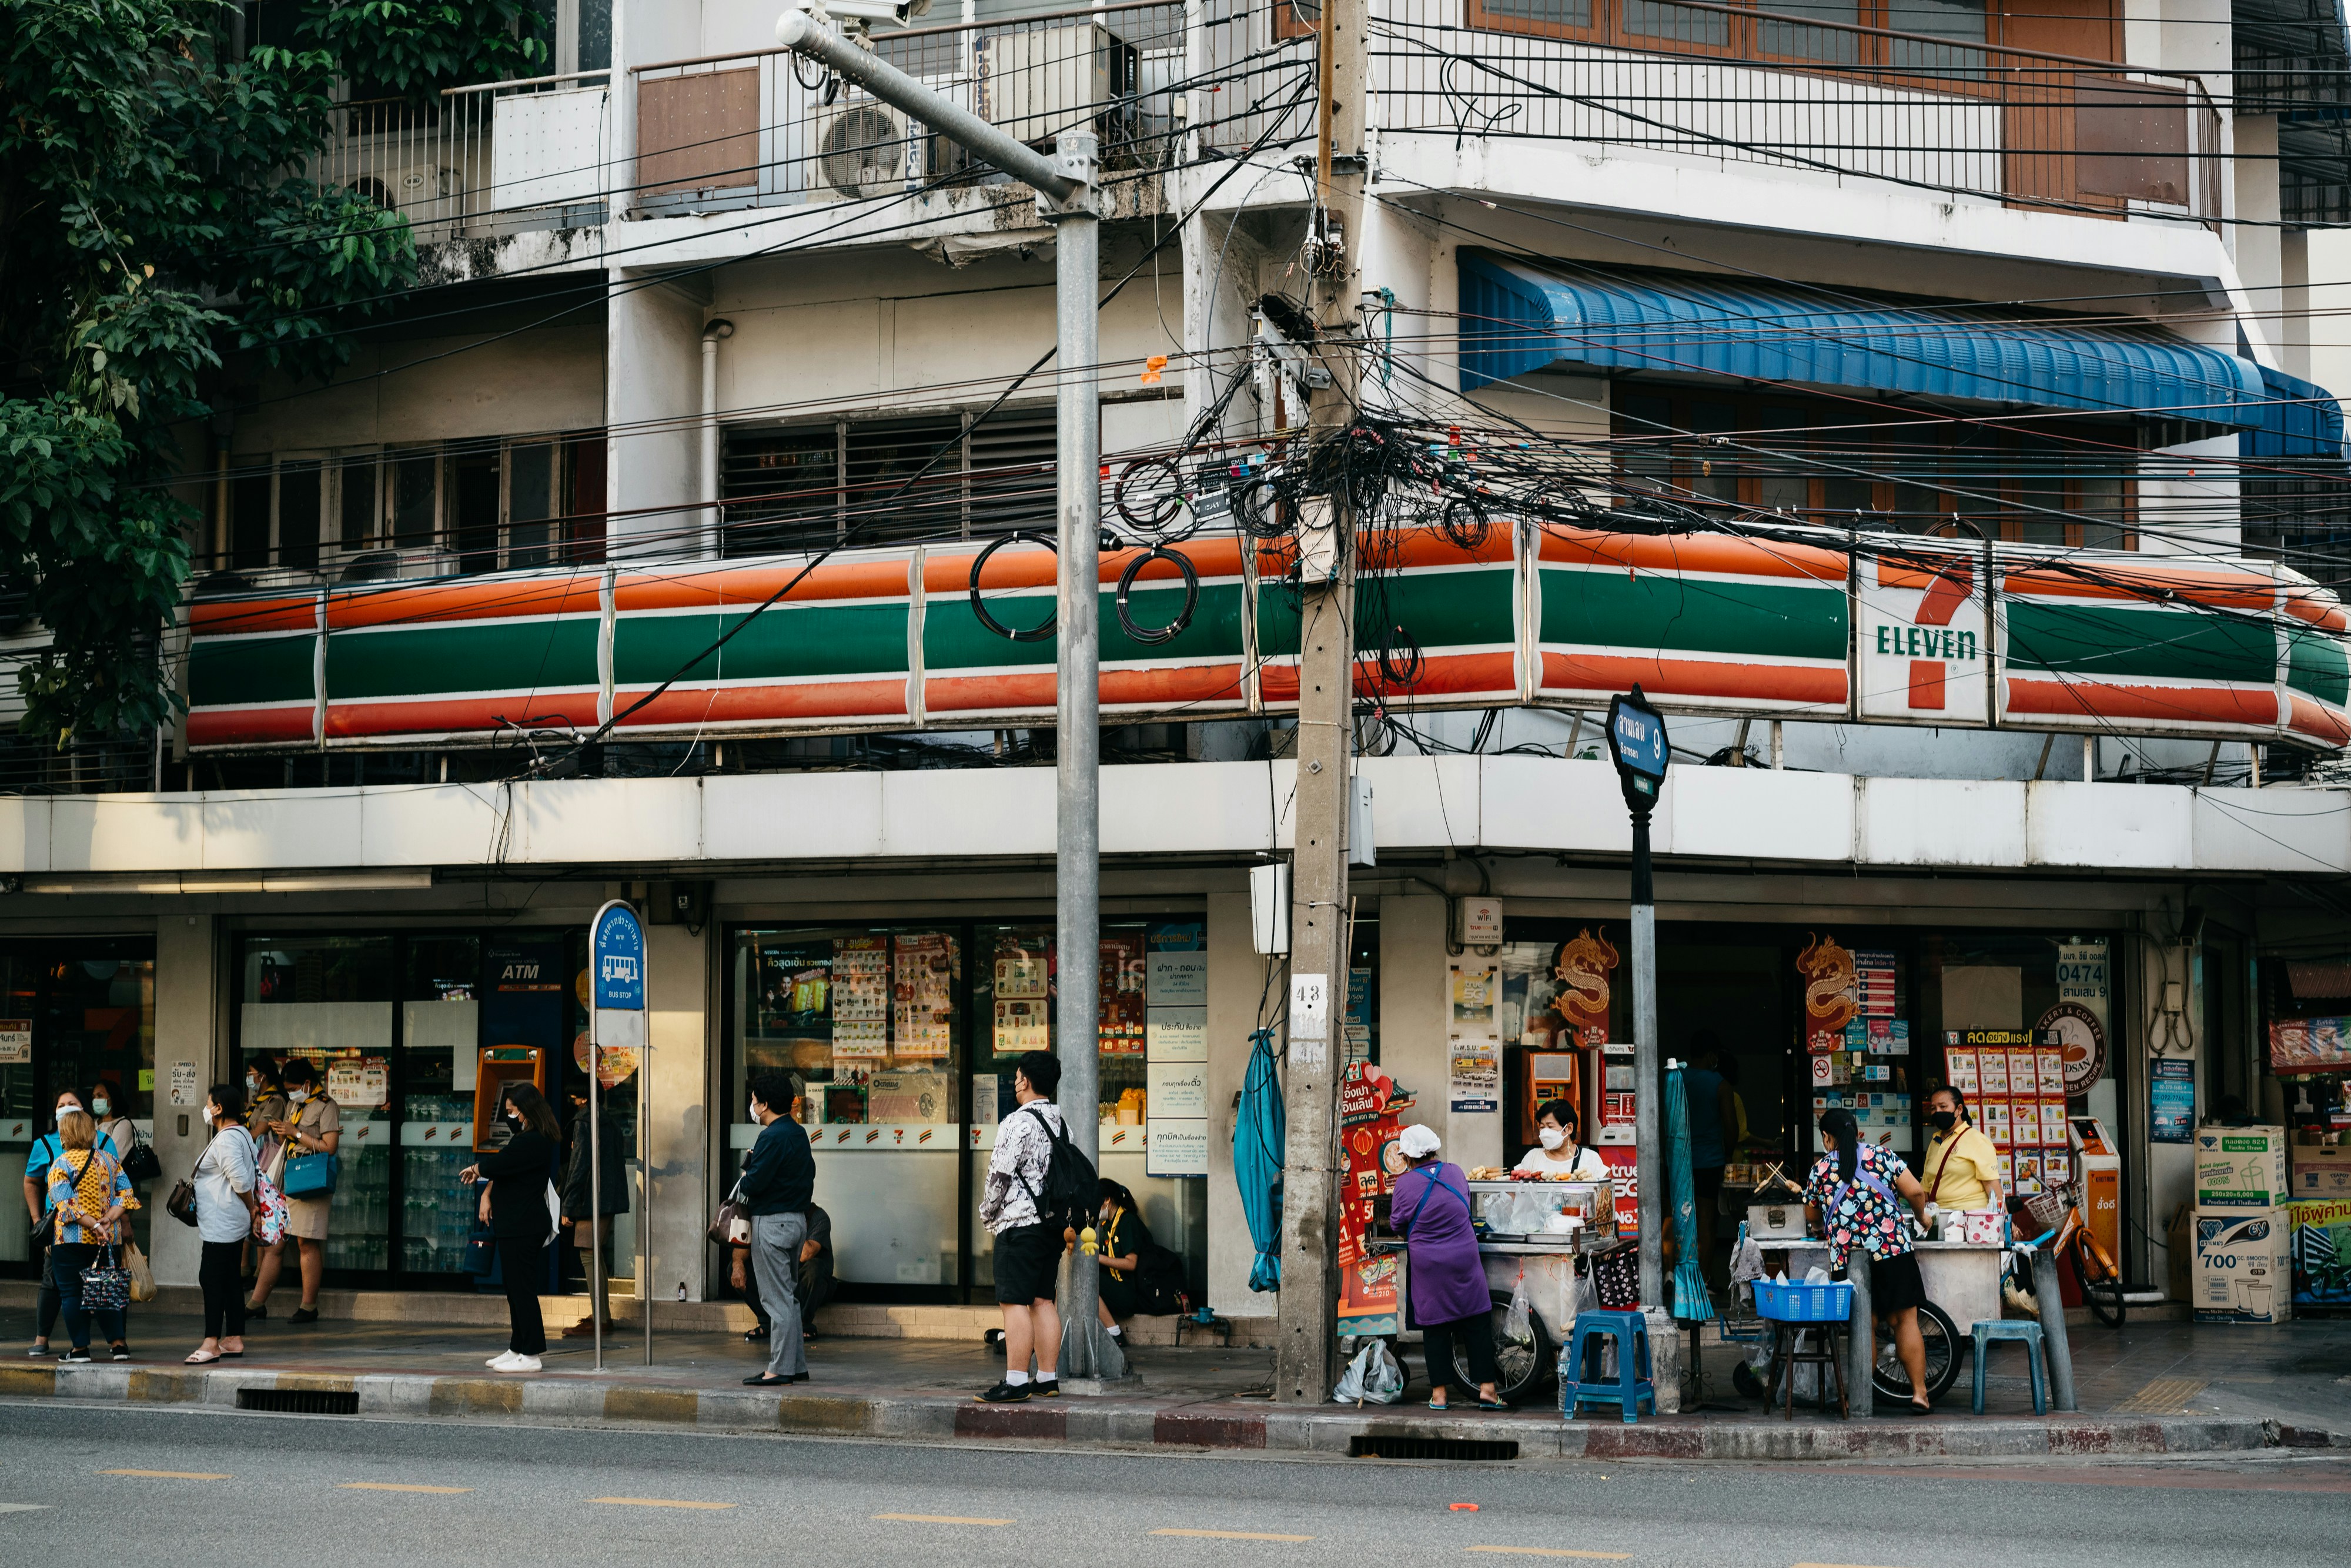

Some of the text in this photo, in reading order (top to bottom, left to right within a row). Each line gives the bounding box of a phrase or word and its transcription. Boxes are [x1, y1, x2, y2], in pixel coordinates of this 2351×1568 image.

[1877, 547, 1973, 710] 7
[1619, 714, 1661, 760] สามเสน 9
[1620, 741, 1638, 759] Samsen
[2079, 951, 2087, 960] ซีพี
[501, 965, 539, 979] ATM
[1158, 963, 1172, 972] ฝาก
[2059, 964, 2103, 982] 0474
[2063, 987, 2106, 998] สามเสน 9
[1162, 1022, 1185, 1031] ประกัน
[2076, 1009, 2102, 1041] COFFEE
[1967, 1029, 2032, 1048] ลด อย่าง แรง!
[172, 1068, 196, 1078] รับ-ส่ง
[2081, 1061, 2101, 1088] RECIPE
[1344, 1084, 1369, 1099] อั่งเปา
[1343, 1096, 1373, 1113] อินเลิฟ
[894, 1129, 903, 1144] 7
[972, 1129, 981, 1144] 7
[2207, 1176, 2230, 1186] 100%
[2097, 1197, 2115, 1210] ชั่งดี
[2202, 1255, 2236, 1269] 700
